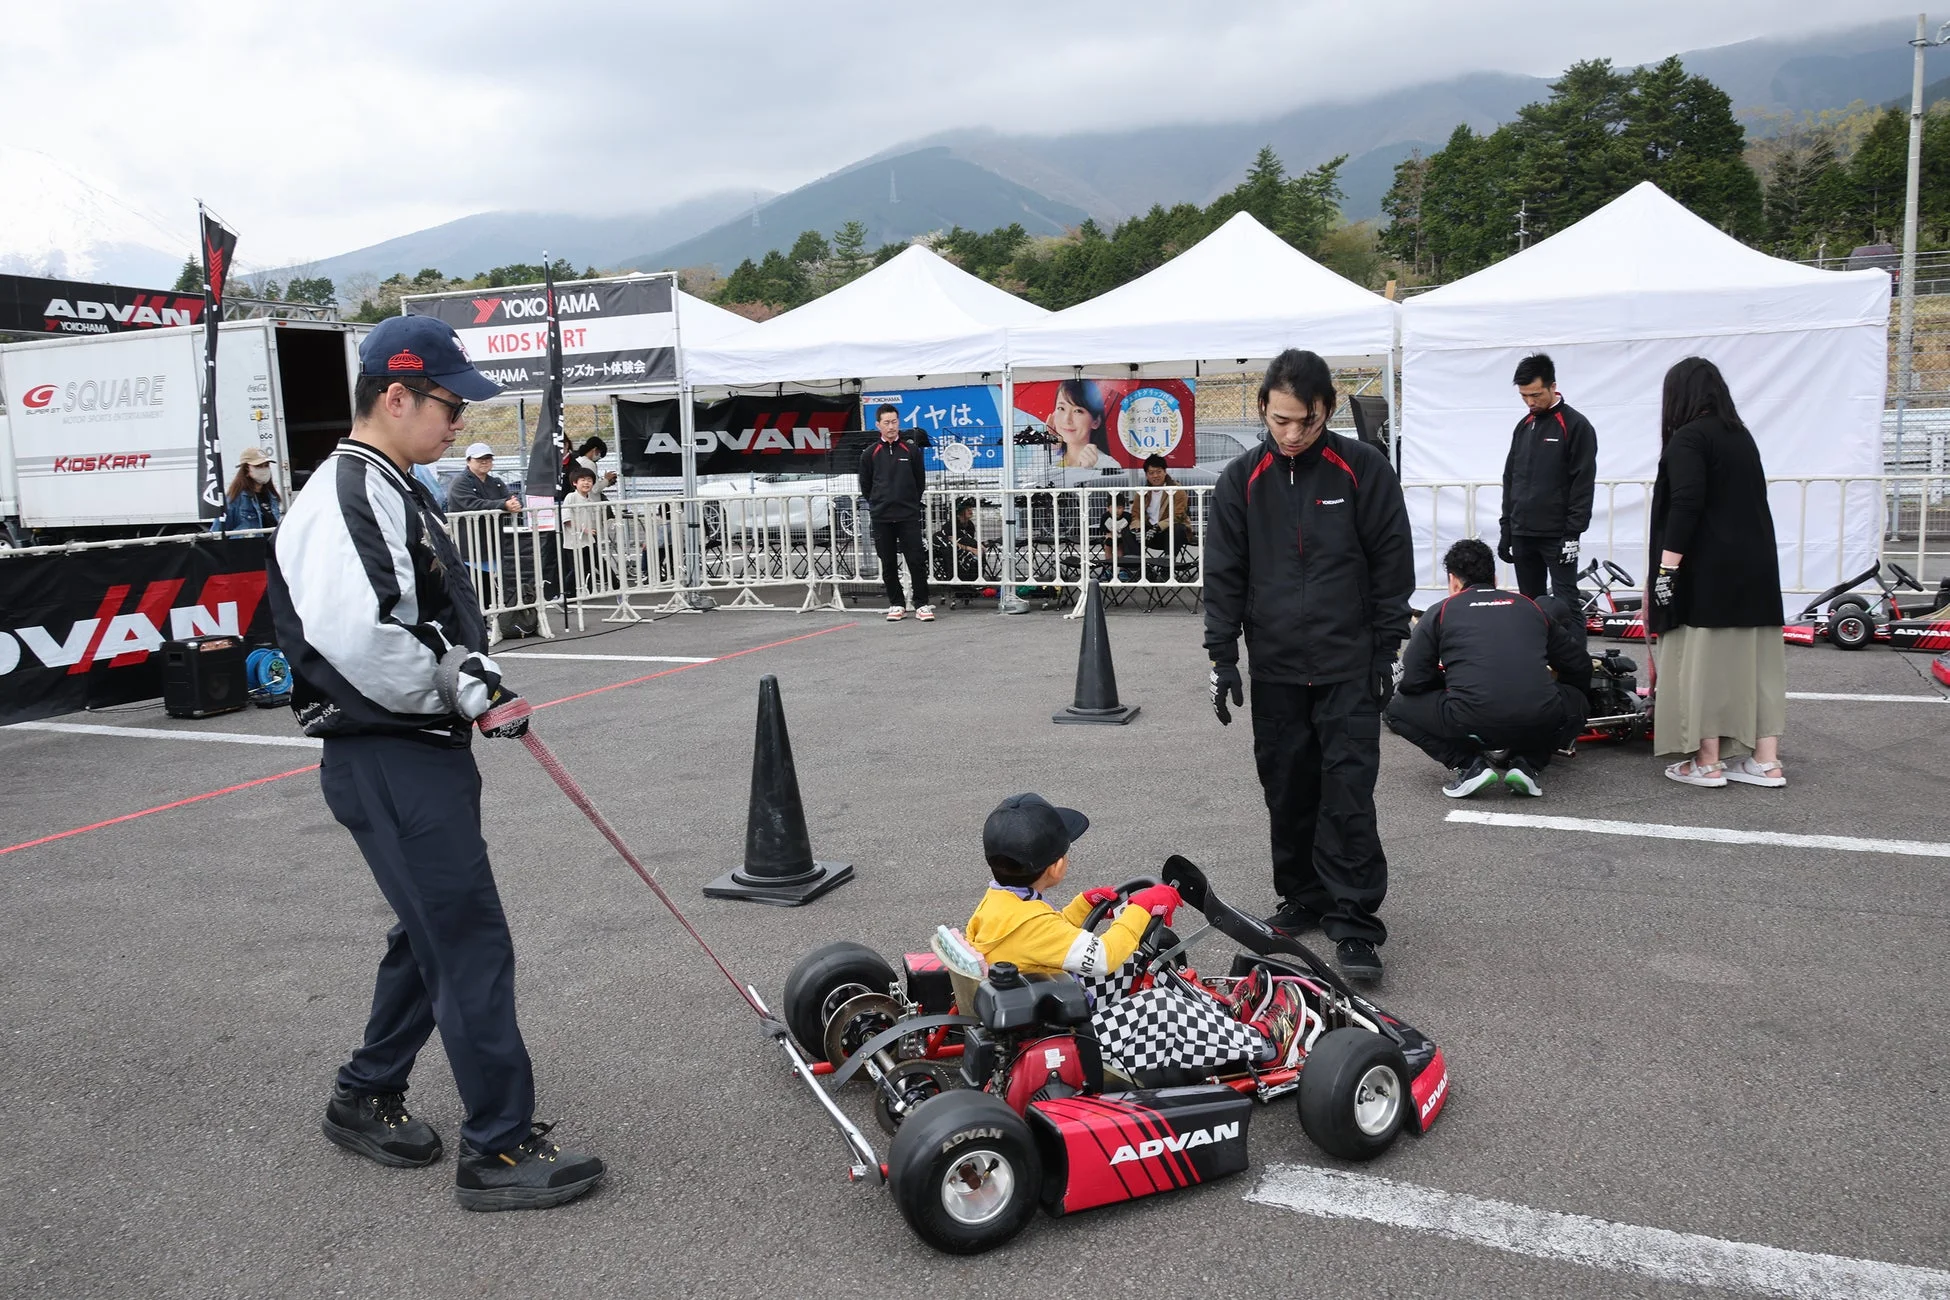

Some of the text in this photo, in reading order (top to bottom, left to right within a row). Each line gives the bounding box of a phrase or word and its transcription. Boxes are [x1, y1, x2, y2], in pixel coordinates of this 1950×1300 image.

[43, 298, 191, 326] ADVAN
[501, 292, 600, 319] YOKOAMA
[59, 321, 110, 333] YOKOHAMA
[488, 332, 531, 354] KIDS
[536, 328, 587, 351] KRT
[62, 375, 166, 413] SQUARE
[644, 427, 832, 454] ADVAN
[1128, 429, 1171, 448] No.1
[0, 601, 240, 676] VAN
[1080, 955, 1096, 975] FUN
[942, 1127, 1005, 1154] ADVAN
[1109, 1121, 1240, 1165] ADVAN
